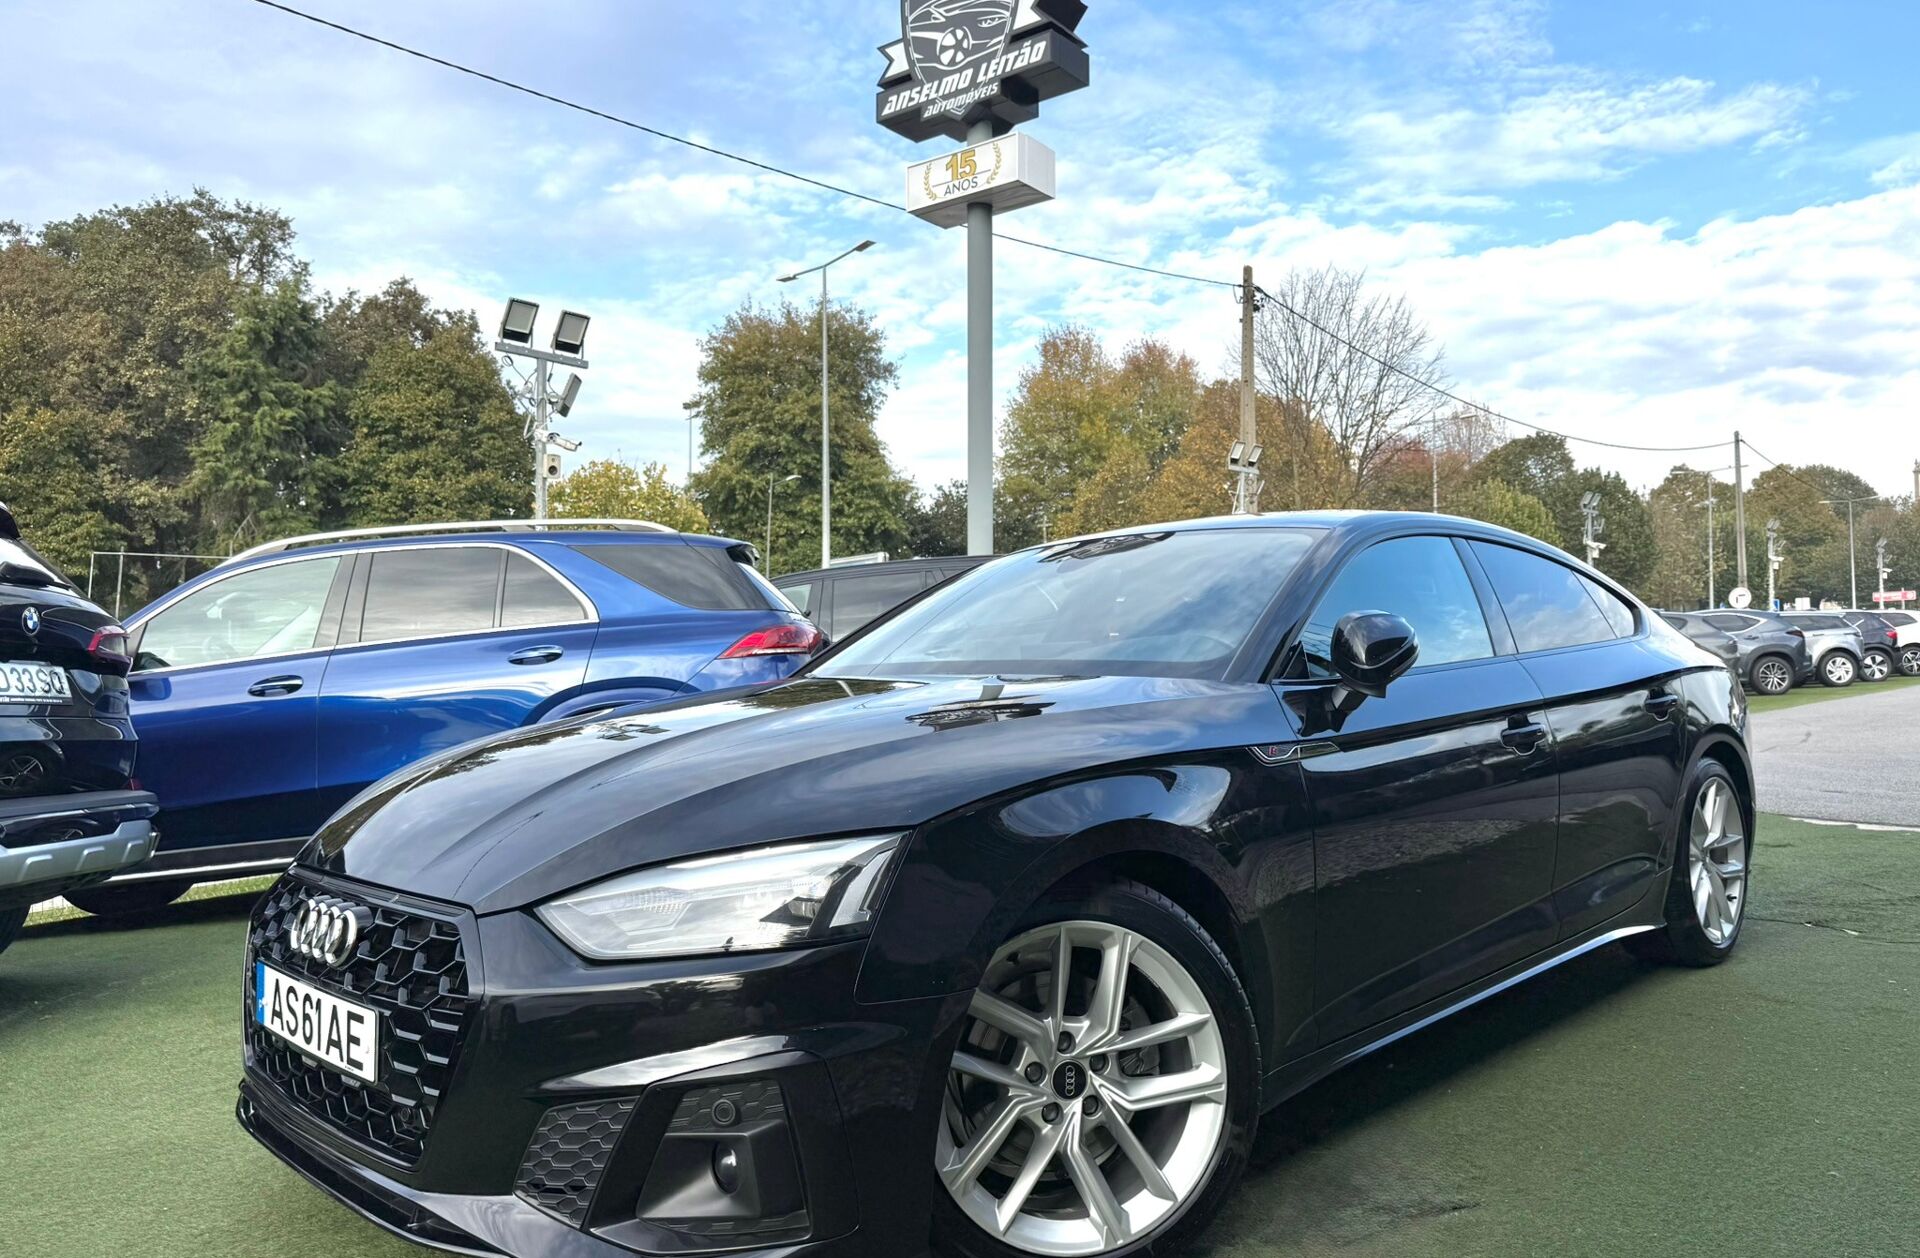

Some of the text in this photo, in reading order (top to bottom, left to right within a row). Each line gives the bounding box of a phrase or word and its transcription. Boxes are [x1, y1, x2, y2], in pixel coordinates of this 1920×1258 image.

[881, 40, 1047, 116] ANSELMO LEITÃO
[943, 176, 978, 197] ANOS
[945, 150, 977, 181] 15
[271, 978, 364, 1071] AS61AE
